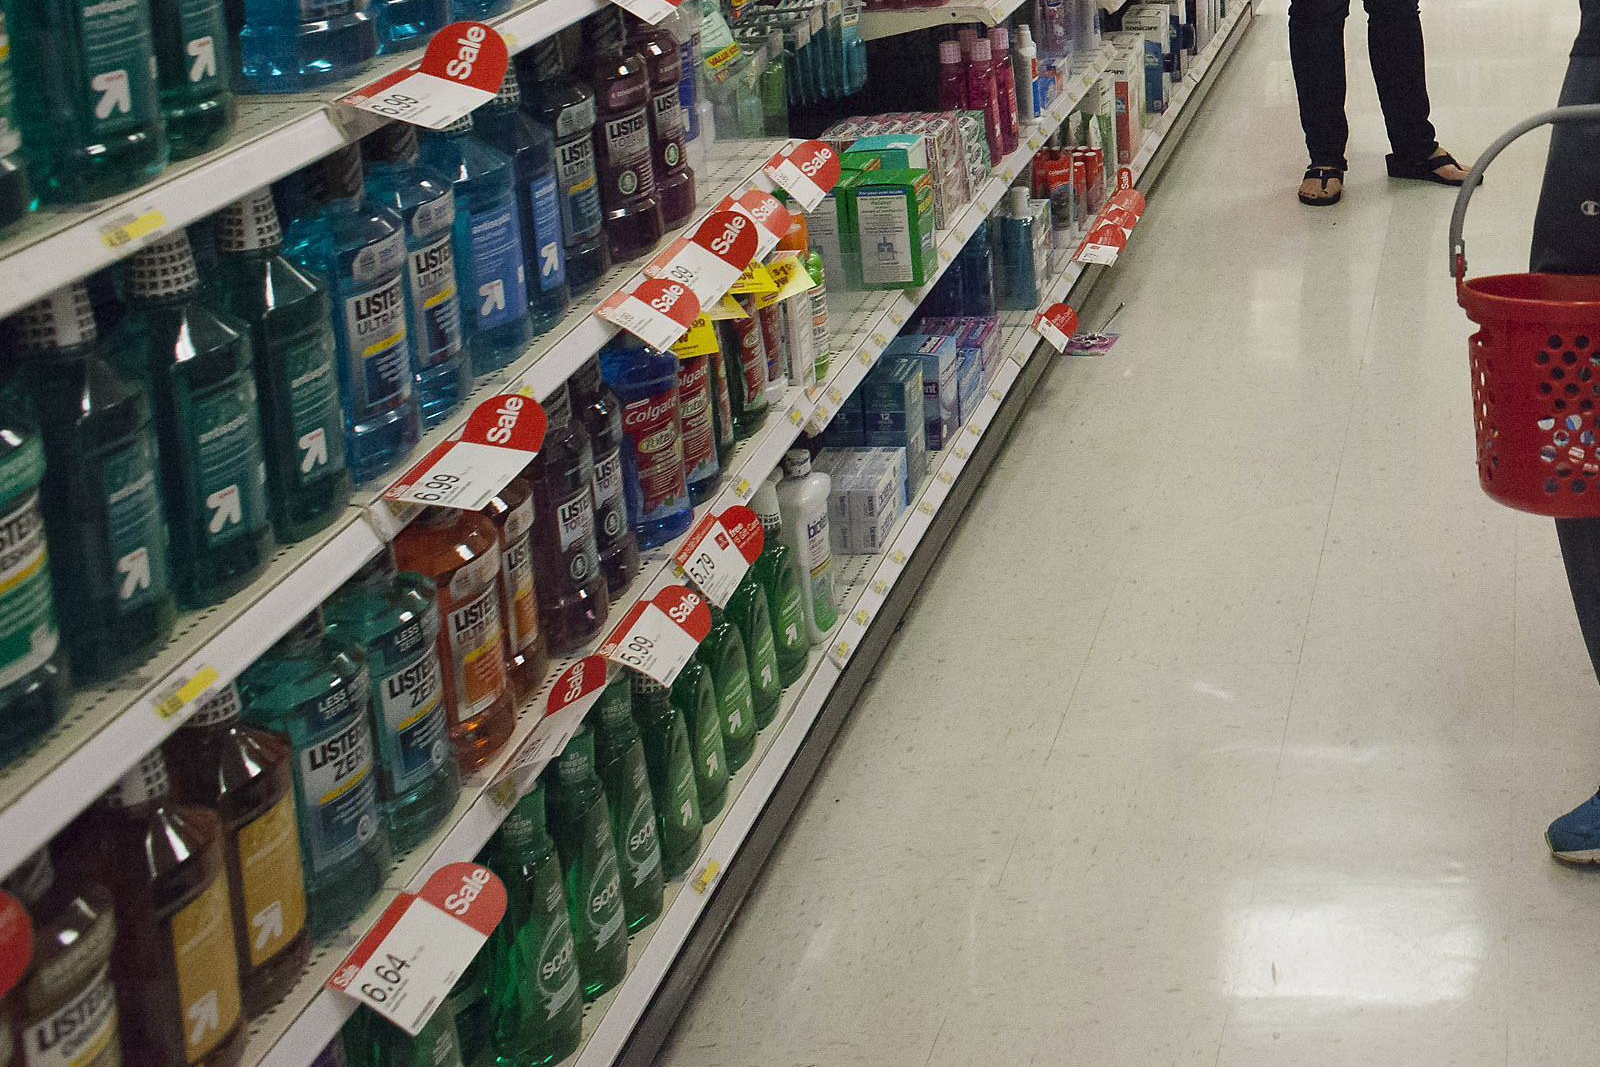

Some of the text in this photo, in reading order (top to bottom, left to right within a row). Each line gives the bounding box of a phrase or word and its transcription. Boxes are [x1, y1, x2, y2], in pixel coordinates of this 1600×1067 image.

[446, 25, 487, 80] Sale
[370, 93, 420, 116] 6.99
[799, 147, 833, 178] Sale
[752, 197, 779, 222] Sale
[711, 215, 747, 255] Sale
[650, 283, 685, 313] Sale
[679, 363, 708, 387] olgate
[486, 396, 524, 444] Sale
[625, 395, 677, 425] Colgate
[412, 472, 461, 502] 6.99
[690, 552, 716, 585] 5.79
[668, 593, 701, 623] Sale
[394, 622, 420, 646] LESS
[619, 635, 655, 666] 5.99
[410, 678, 436, 709] ZER
[563, 660, 586, 703] Sale
[318, 688, 347, 713] LESS
[333, 744, 364, 782] ZER
[444, 865, 491, 917] Sale
[361, 952, 411, 1004] 6.64
